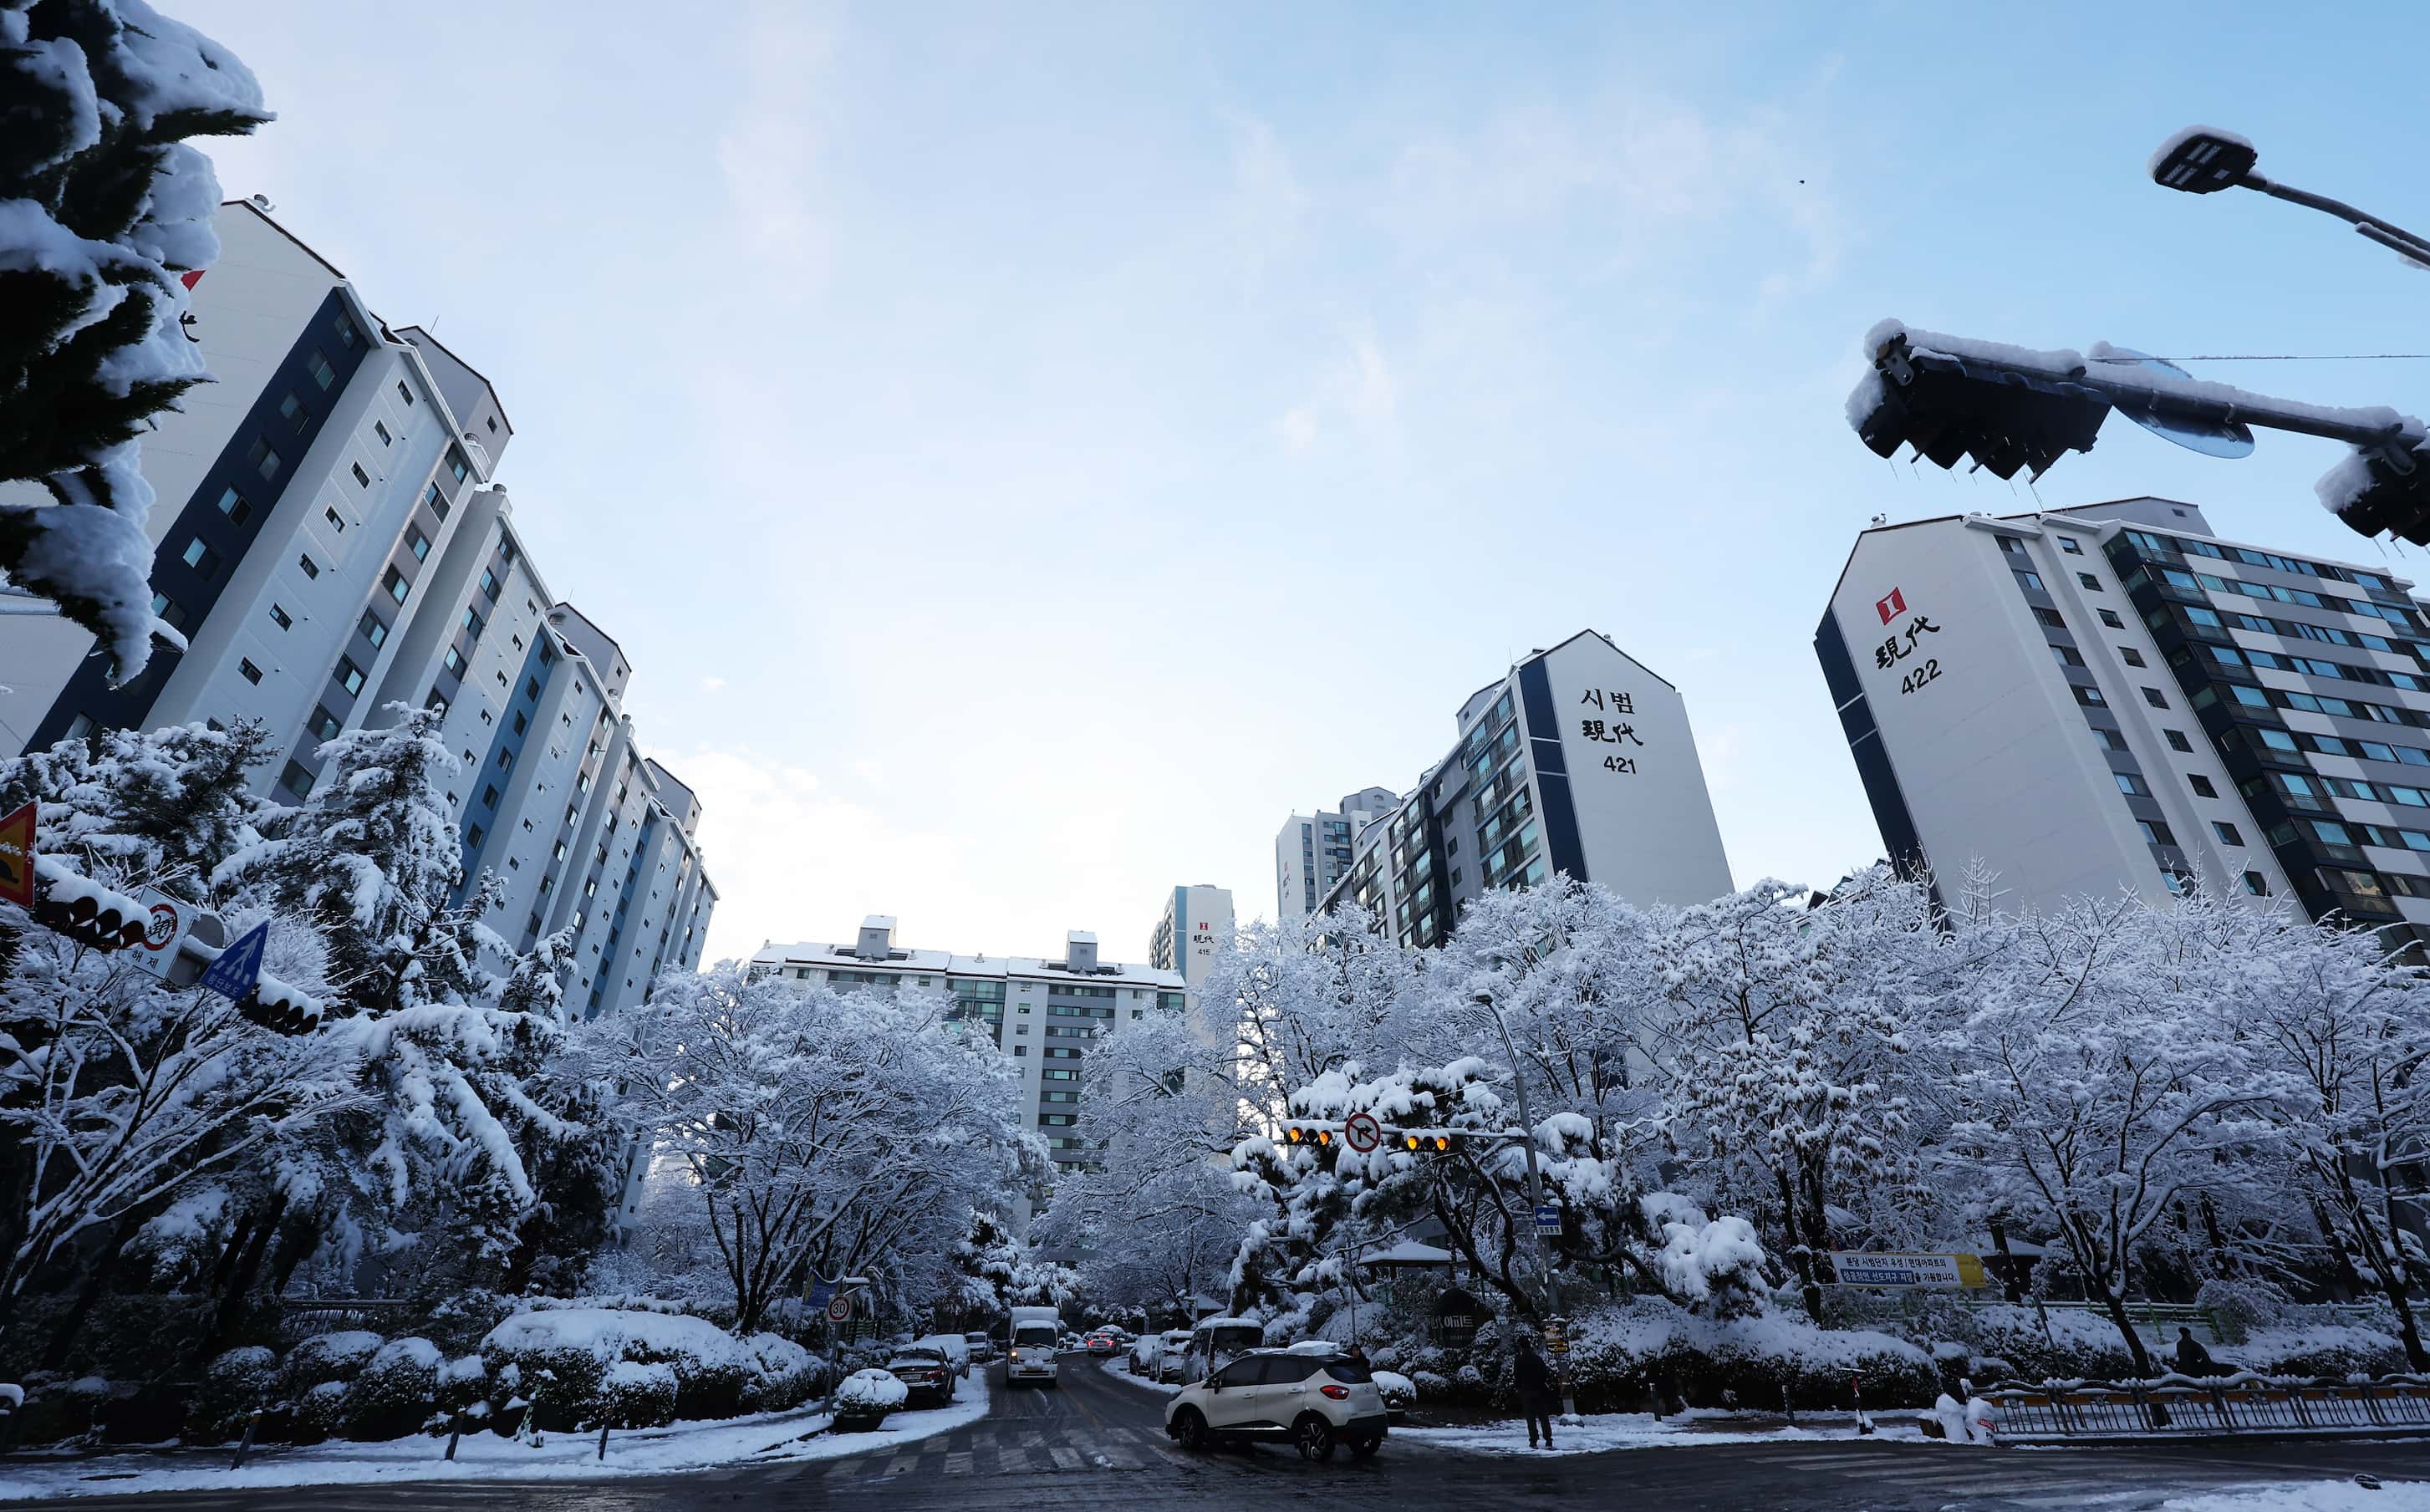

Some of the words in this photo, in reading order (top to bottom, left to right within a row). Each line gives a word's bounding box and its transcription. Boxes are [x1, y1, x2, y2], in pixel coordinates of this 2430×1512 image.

[1876, 616, 1941, 669] 現代
[1902, 659, 1942, 695] 422
[1581, 688, 1635, 714] 시범
[1582, 720, 1643, 746] 現代
[1604, 756, 1636, 774] 421
[1846, 1256, 1859, 1267] 분당
[1862, 1257, 1888, 1267] 시범단지
[1891, 1257, 1903, 1268] 우성
[833, 1303, 846, 1314] 30
